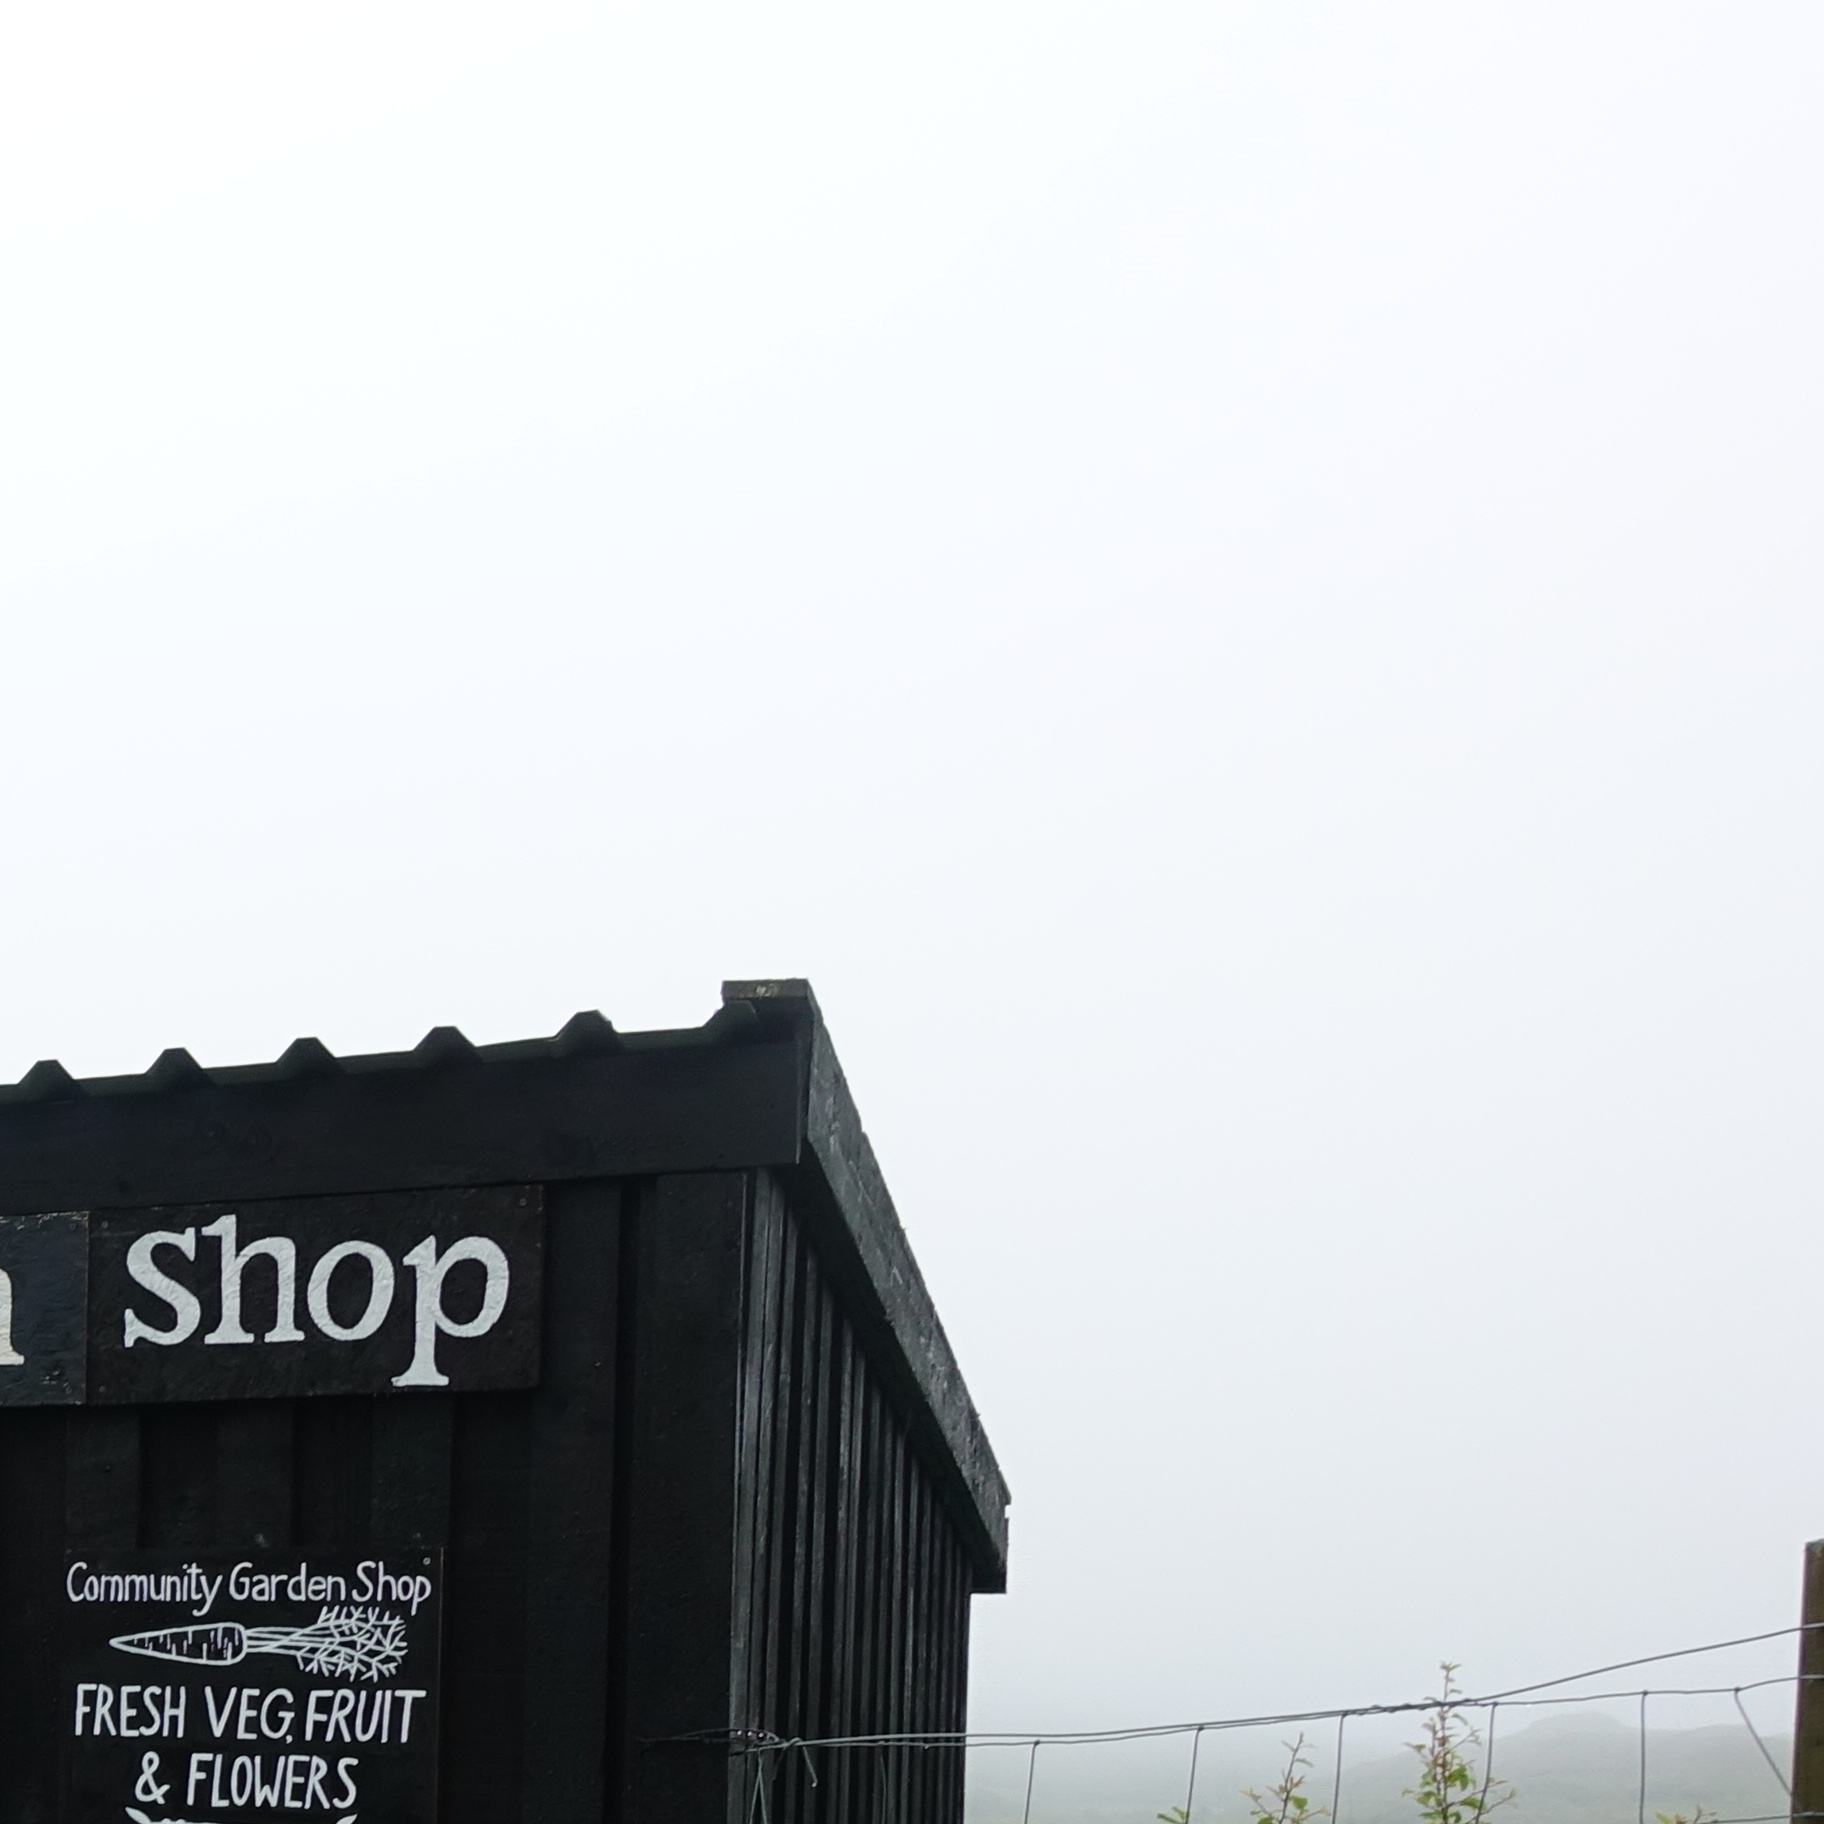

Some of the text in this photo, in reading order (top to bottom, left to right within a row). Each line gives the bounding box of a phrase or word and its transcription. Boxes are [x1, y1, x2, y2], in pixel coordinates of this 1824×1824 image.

[66, 1561, 432, 1617] Community Garden Shop
[75, 1683, 186, 1738] FRESH
[305, 1688, 427, 1744] FRUIT
[134, 1751, 359, 1810] & FLOWERS
